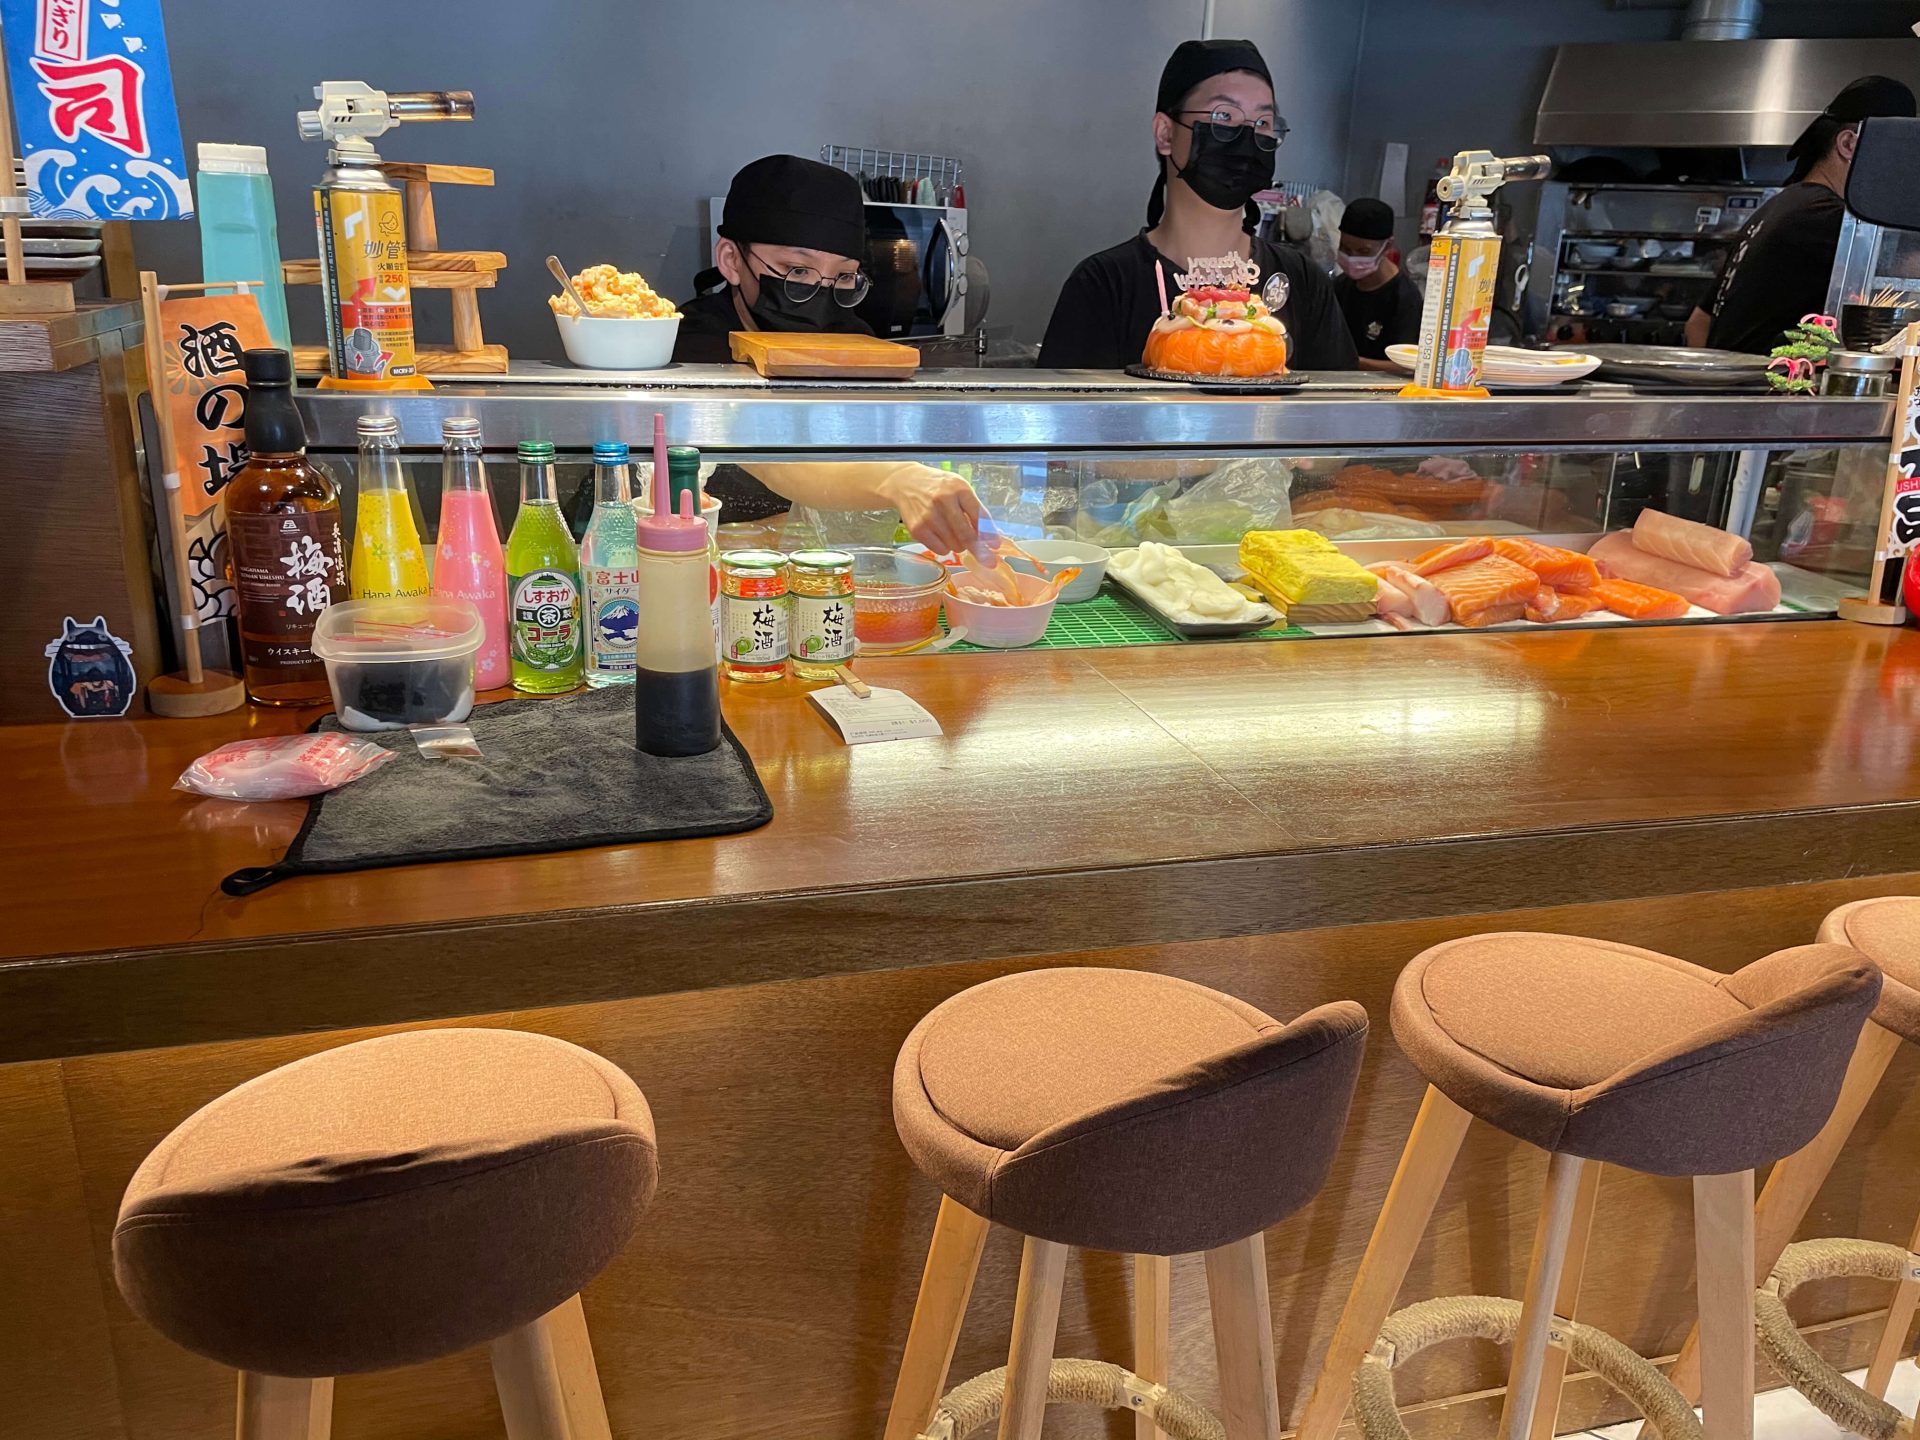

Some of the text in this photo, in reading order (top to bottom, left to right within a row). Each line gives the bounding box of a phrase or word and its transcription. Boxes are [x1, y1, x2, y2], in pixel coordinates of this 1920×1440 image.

[363, 587, 428, 599] Hana Awaka
[457, 589, 495, 599] Awaka
[527, 624, 571, 642] コーラ
[752, 604, 776, 651] 梅酒
[822, 602, 845, 648] 梅酒
